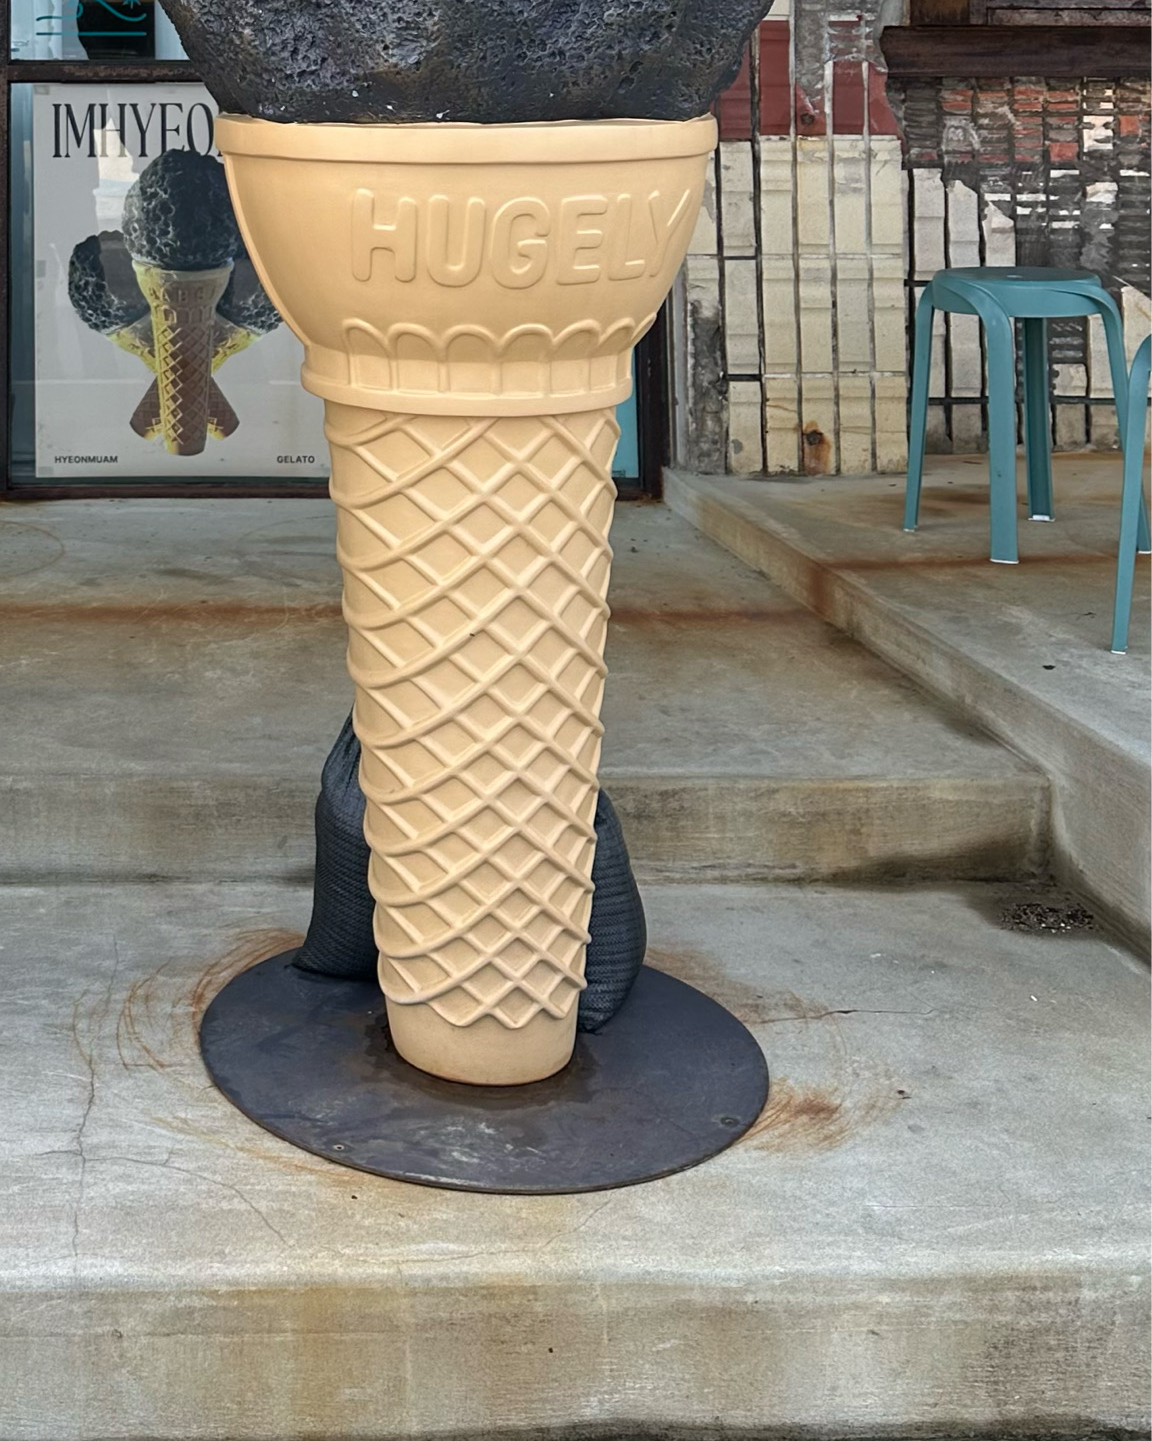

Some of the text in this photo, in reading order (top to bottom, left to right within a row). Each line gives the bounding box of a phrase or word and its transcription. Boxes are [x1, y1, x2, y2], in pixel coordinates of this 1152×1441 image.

[51, 102, 224, 159] IMHYEO
[351, 187, 691, 290] HUGELY
[54, 455, 119, 464] HYEONMUAM
[276, 455, 316, 464] GELATO
